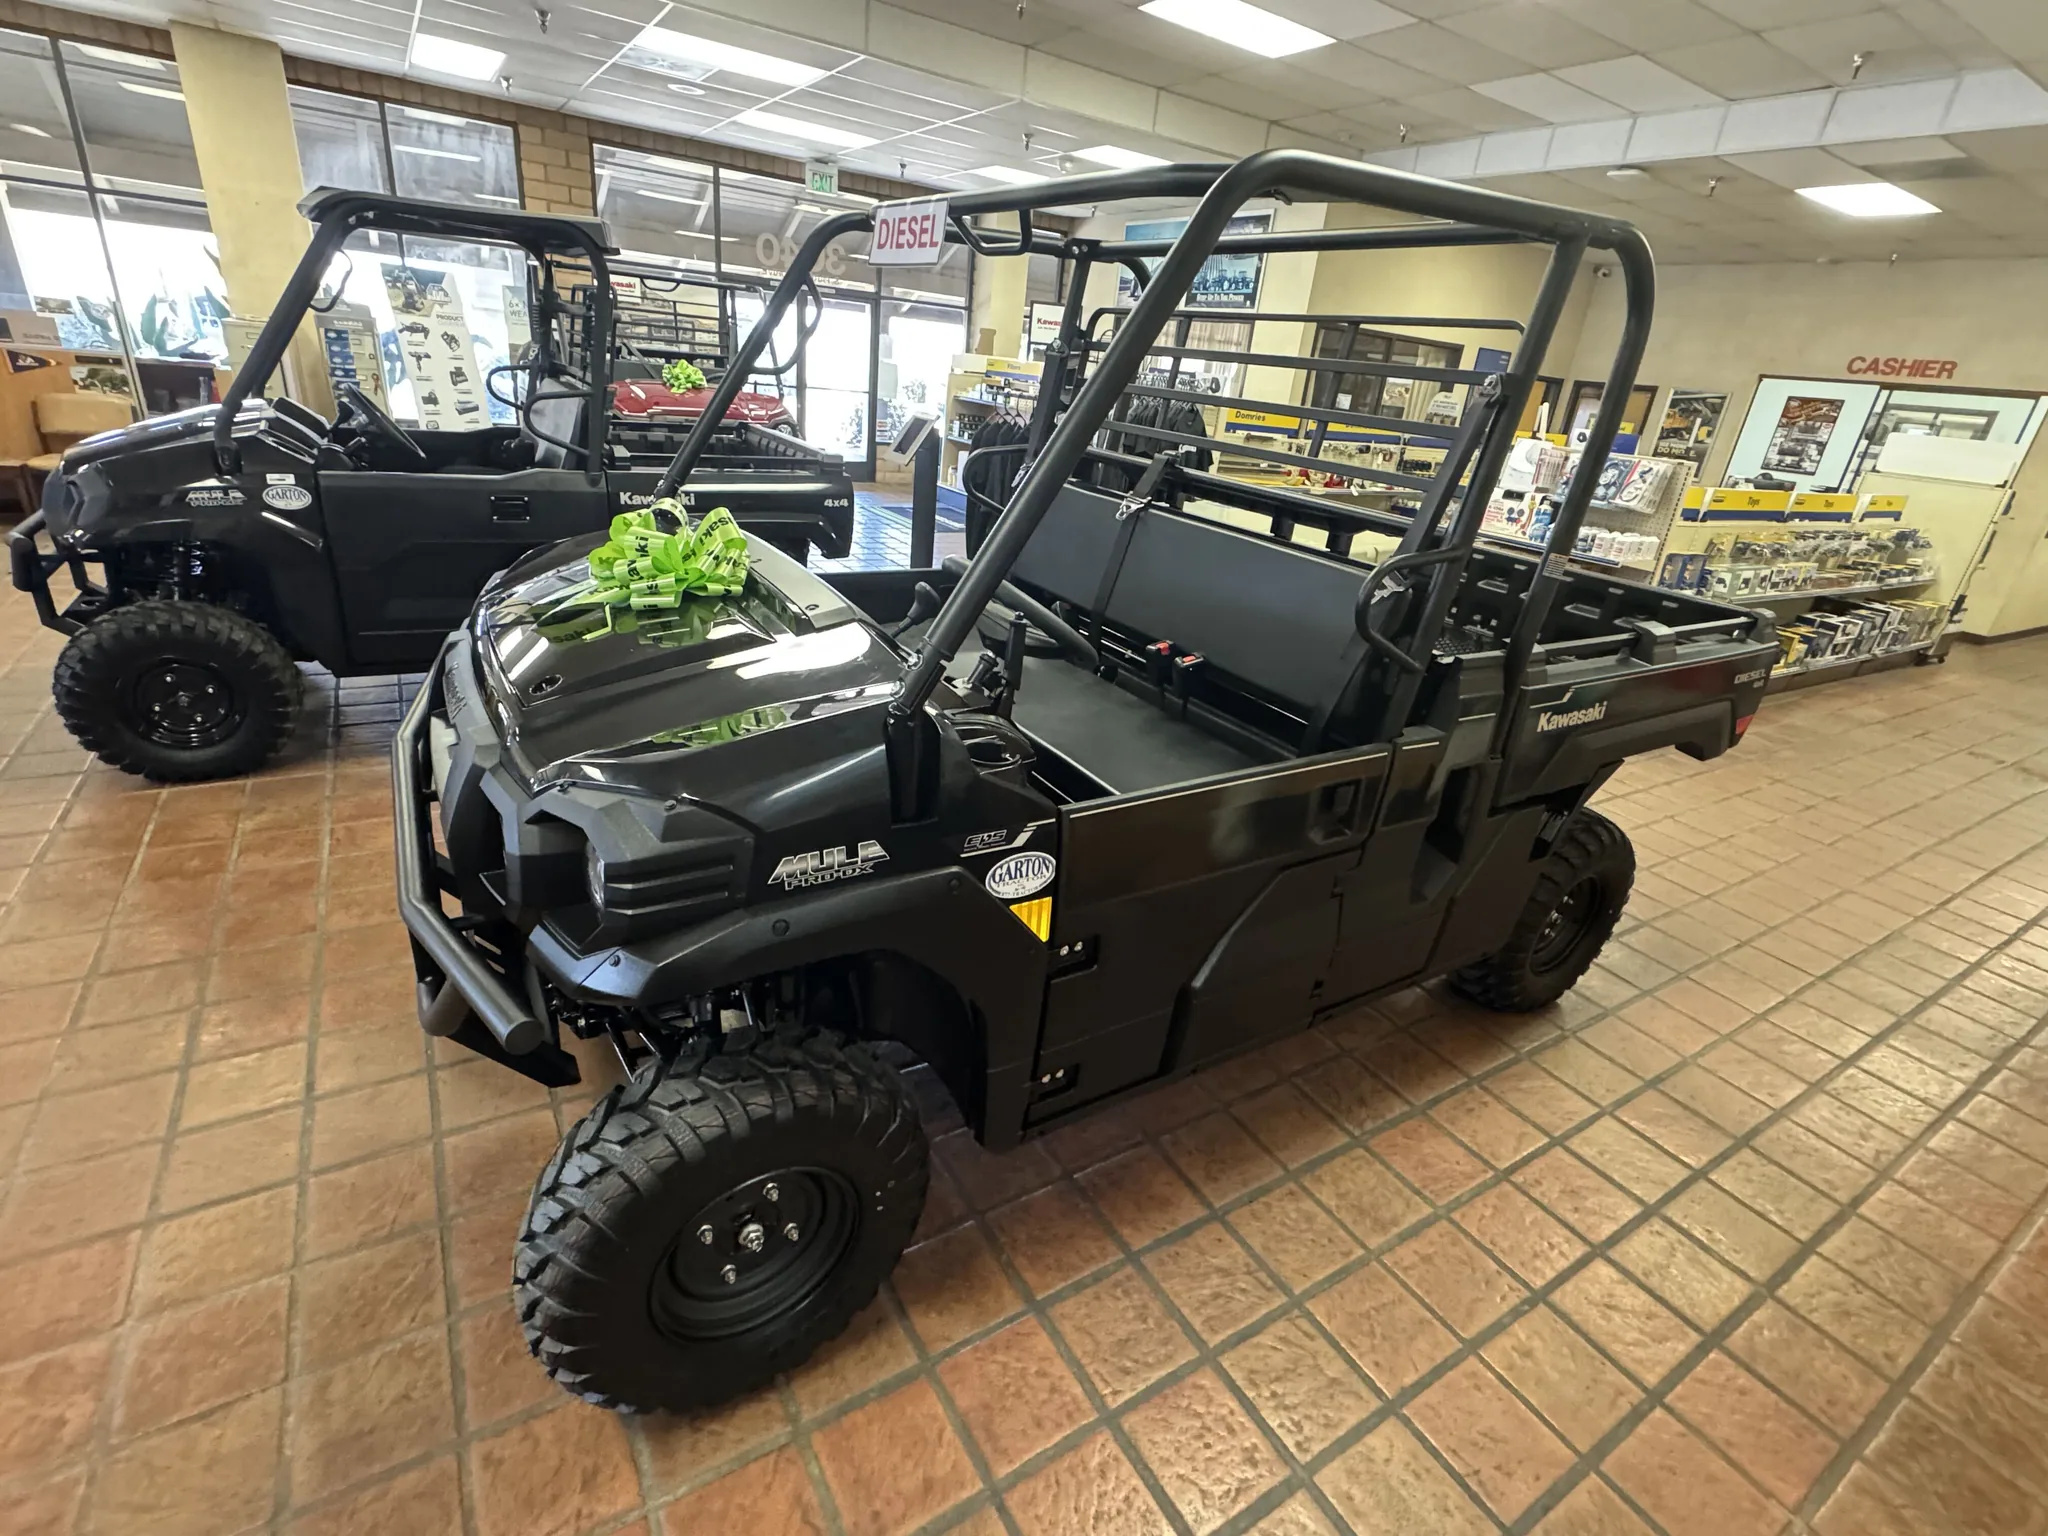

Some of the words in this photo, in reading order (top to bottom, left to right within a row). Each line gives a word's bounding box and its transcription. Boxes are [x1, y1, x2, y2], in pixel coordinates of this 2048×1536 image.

[812, 172, 834, 193] EXIT
[877, 214, 939, 249] DIESEL
[1846, 356, 1958, 379] CASHIER
[1235, 410, 1266, 422] Domries
[266, 487, 306, 501] GARTON
[824, 498, 849, 507] 4x4
[1733, 669, 1766, 684] DIESEL
[1536, 701, 1608, 732] Kawasaki
[768, 840, 890, 884] MULE
[991, 856, 1051, 884] GARTON
[784, 863, 874, 890] PRO-DX
[996, 874, 1047, 888] TRACTOR
